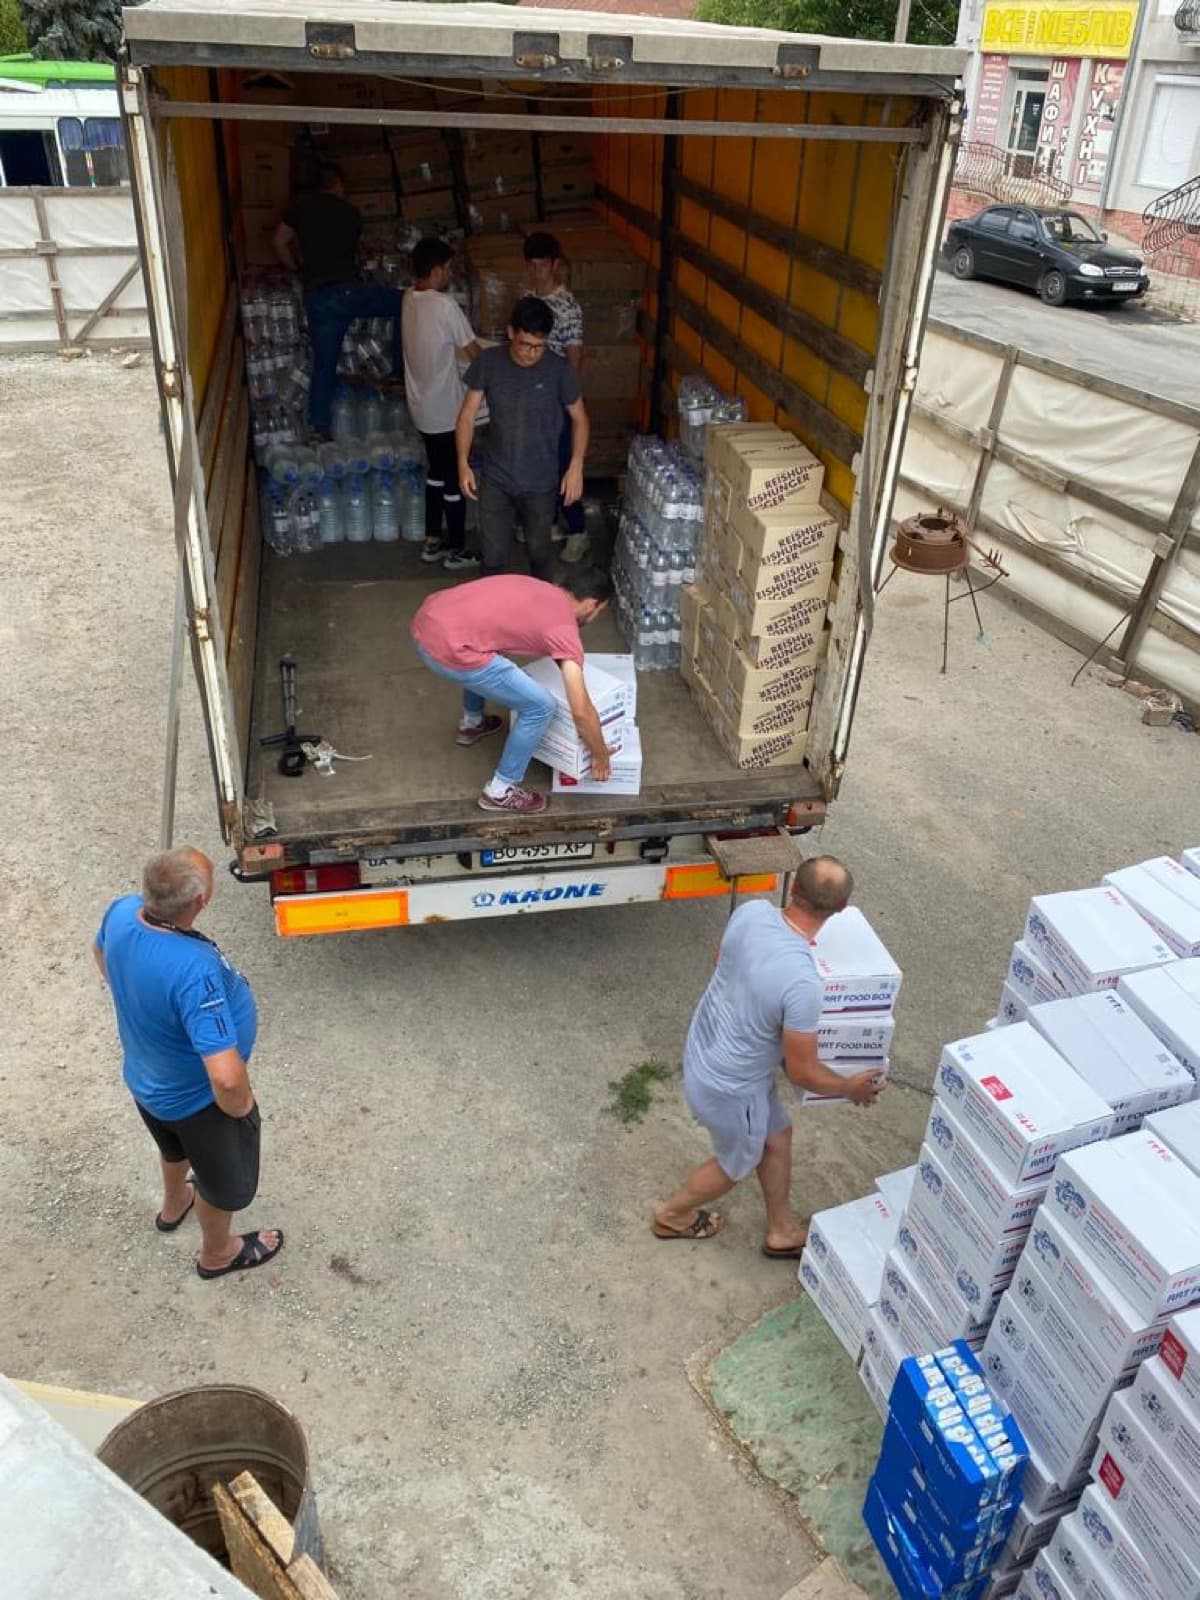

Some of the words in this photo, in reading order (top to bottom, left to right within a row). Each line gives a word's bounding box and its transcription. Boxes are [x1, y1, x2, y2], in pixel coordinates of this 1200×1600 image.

[984, 9, 1027, 43] ВСЕ
[1041, 60, 1068, 142] ШАФИ
[1077, 63, 1110, 184] КУХНІ
[500, 883, 607, 905] KRONE
[844, 994, 871, 1002] FOOD
[872, 992, 892, 1001] BOX
[835, 1042, 862, 1051] FOOD
[863, 1042, 884, 1050] BOX
